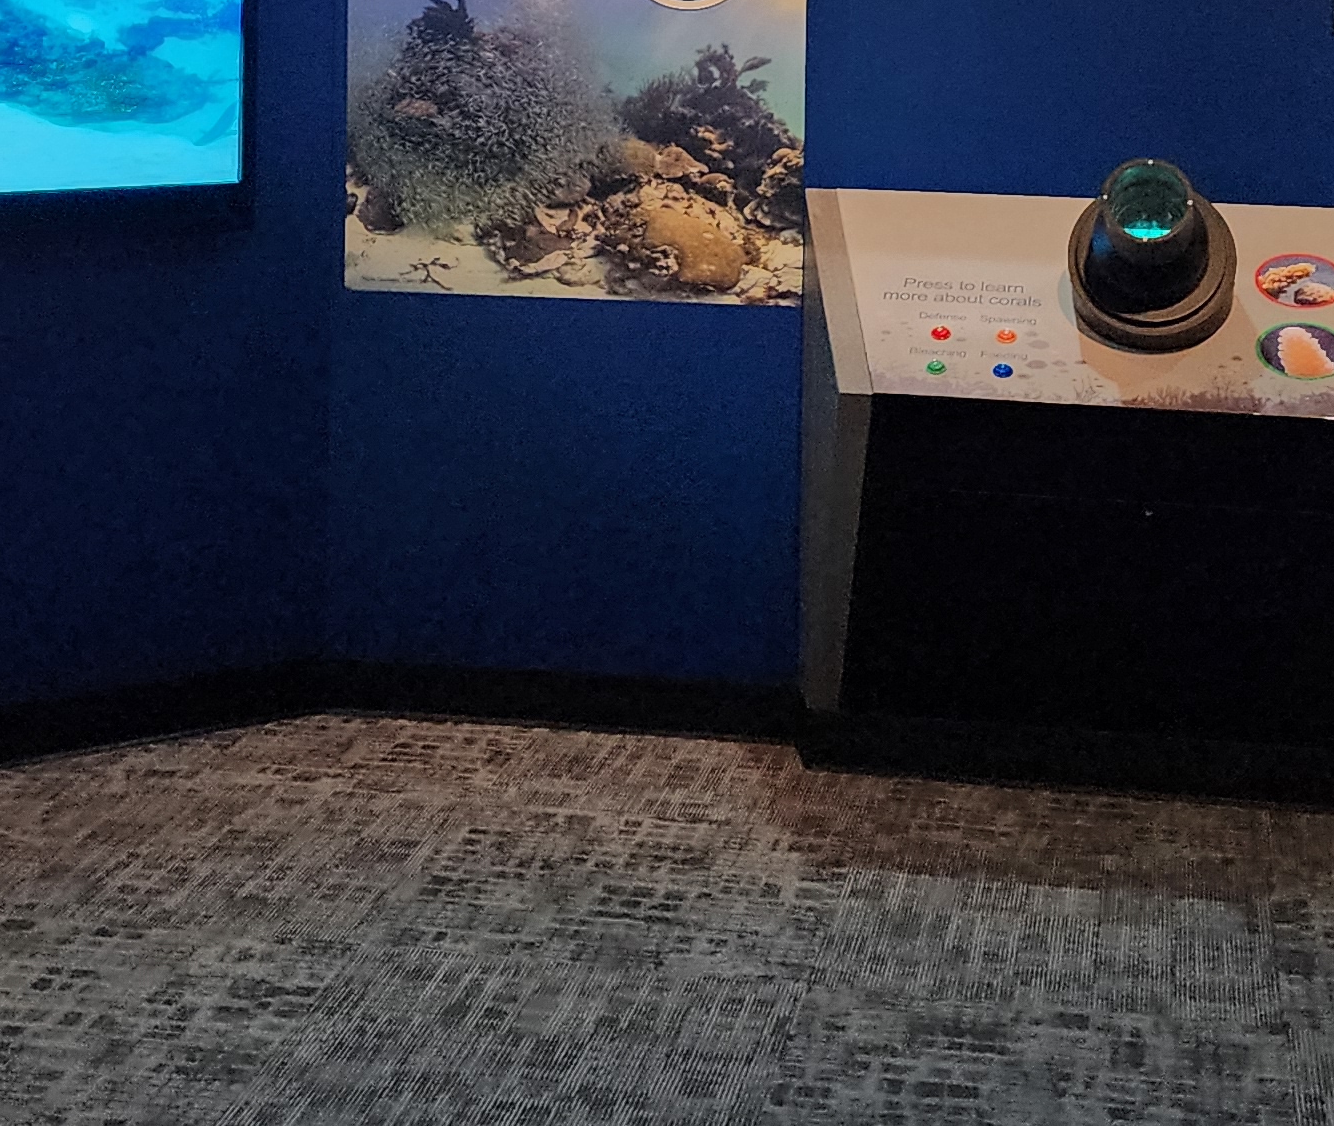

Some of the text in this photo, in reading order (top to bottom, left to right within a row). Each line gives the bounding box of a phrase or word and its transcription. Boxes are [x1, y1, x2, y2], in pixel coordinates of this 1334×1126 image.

[903, 277, 1024, 294] Press to learn
[883, 291, 1042, 307] more about corals
